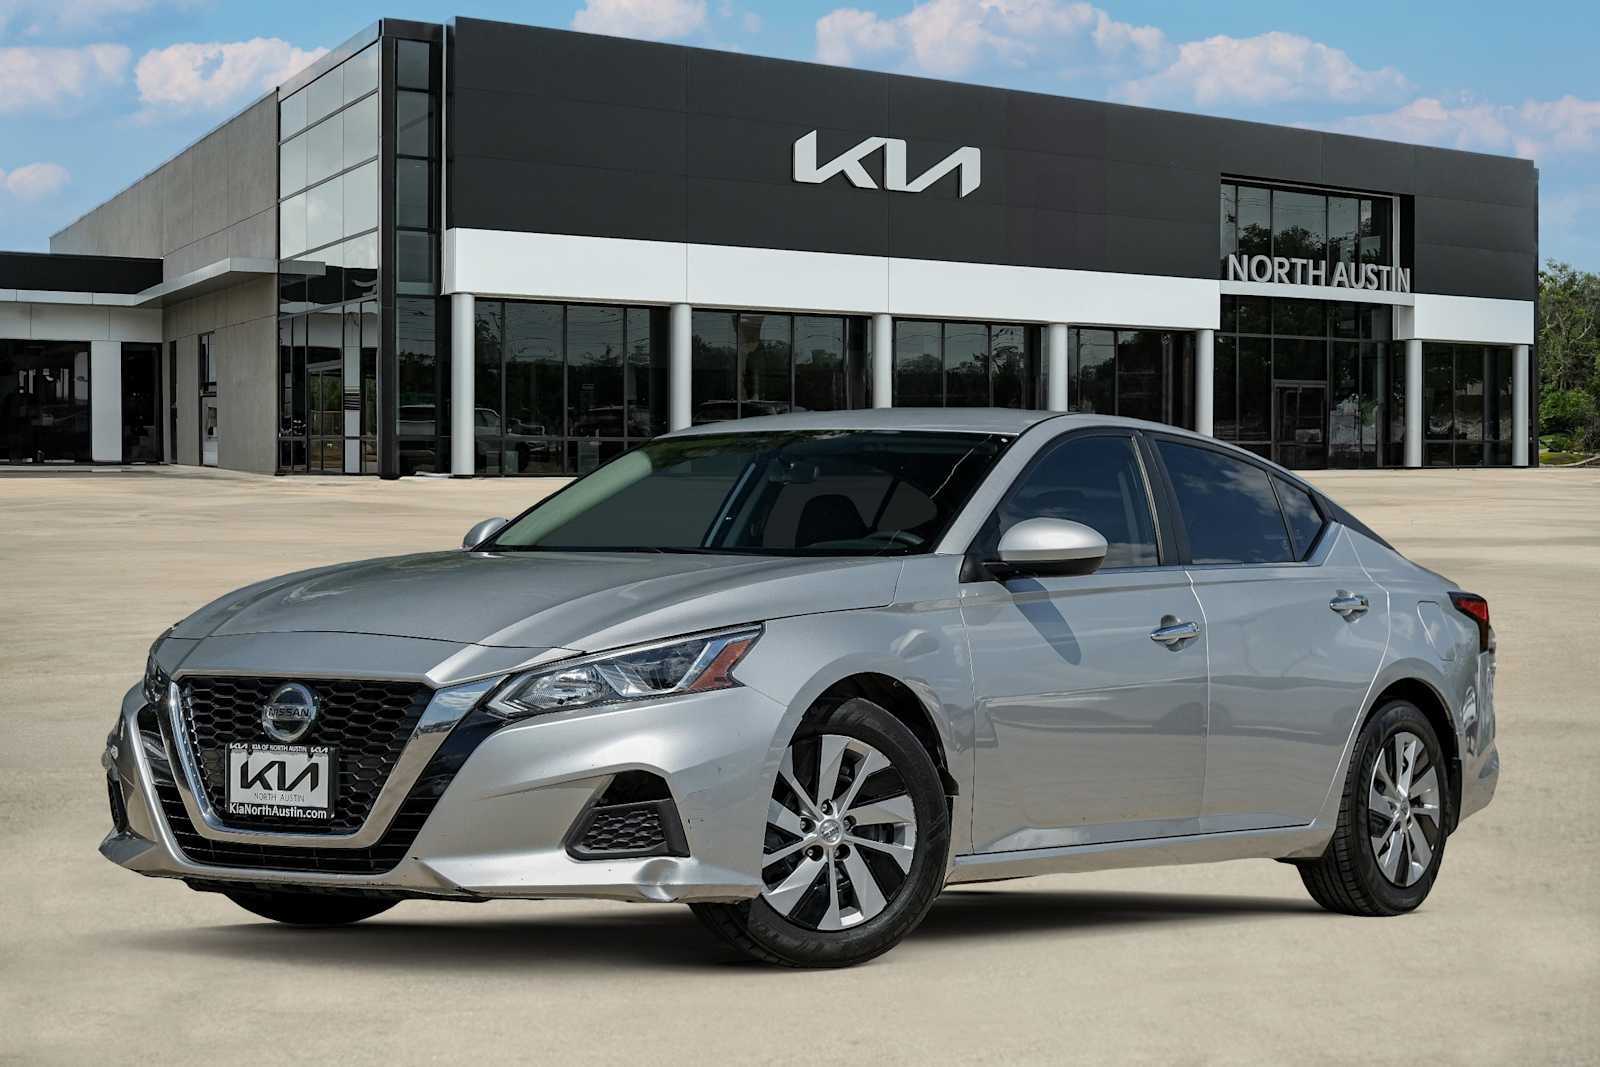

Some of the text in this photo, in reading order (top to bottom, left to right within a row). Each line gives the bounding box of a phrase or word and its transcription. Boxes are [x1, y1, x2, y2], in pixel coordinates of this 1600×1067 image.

[794, 129, 981, 198] KIA
[1227, 254, 1411, 293] NORTH AUSTIN
[268, 708, 310, 719] NISSAN
[240, 760, 319, 792] KIA
[254, 792, 305, 803] NORTH AUSTIN
[229, 802, 327, 819] KiaNorthAustin.com
